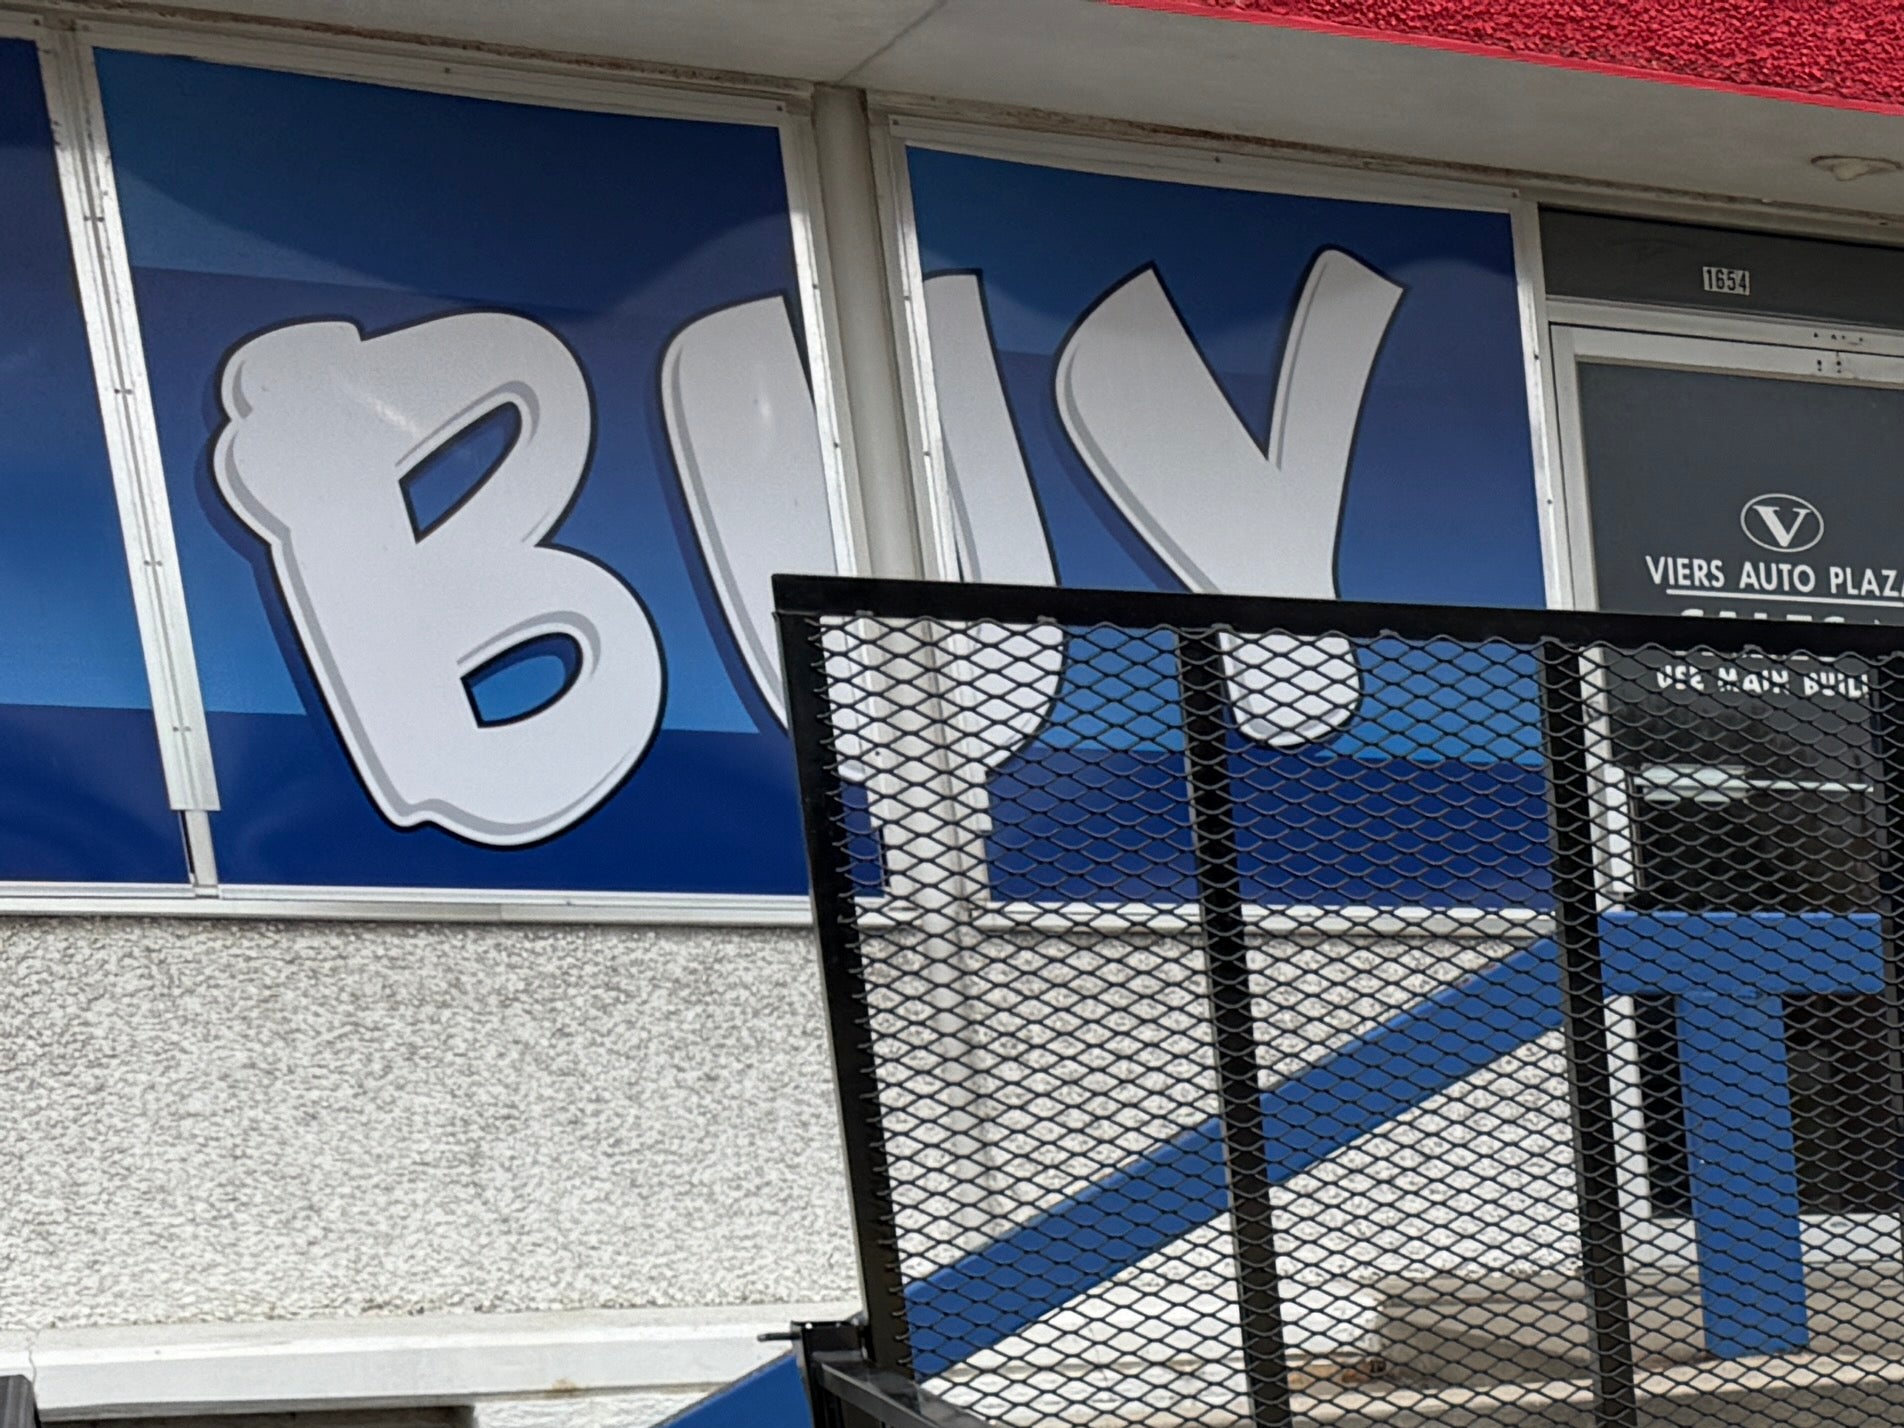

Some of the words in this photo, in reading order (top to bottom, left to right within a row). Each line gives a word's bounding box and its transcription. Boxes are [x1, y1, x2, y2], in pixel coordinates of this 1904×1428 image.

[1706, 269, 1747, 294] 1654
[1752, 505, 1811, 547] V
[213, 247, 1403, 848] BUY
[1645, 555, 1725, 588] VIERS
[1739, 561, 1816, 592] AUTO
[1717, 667, 1790, 695] MAIN
